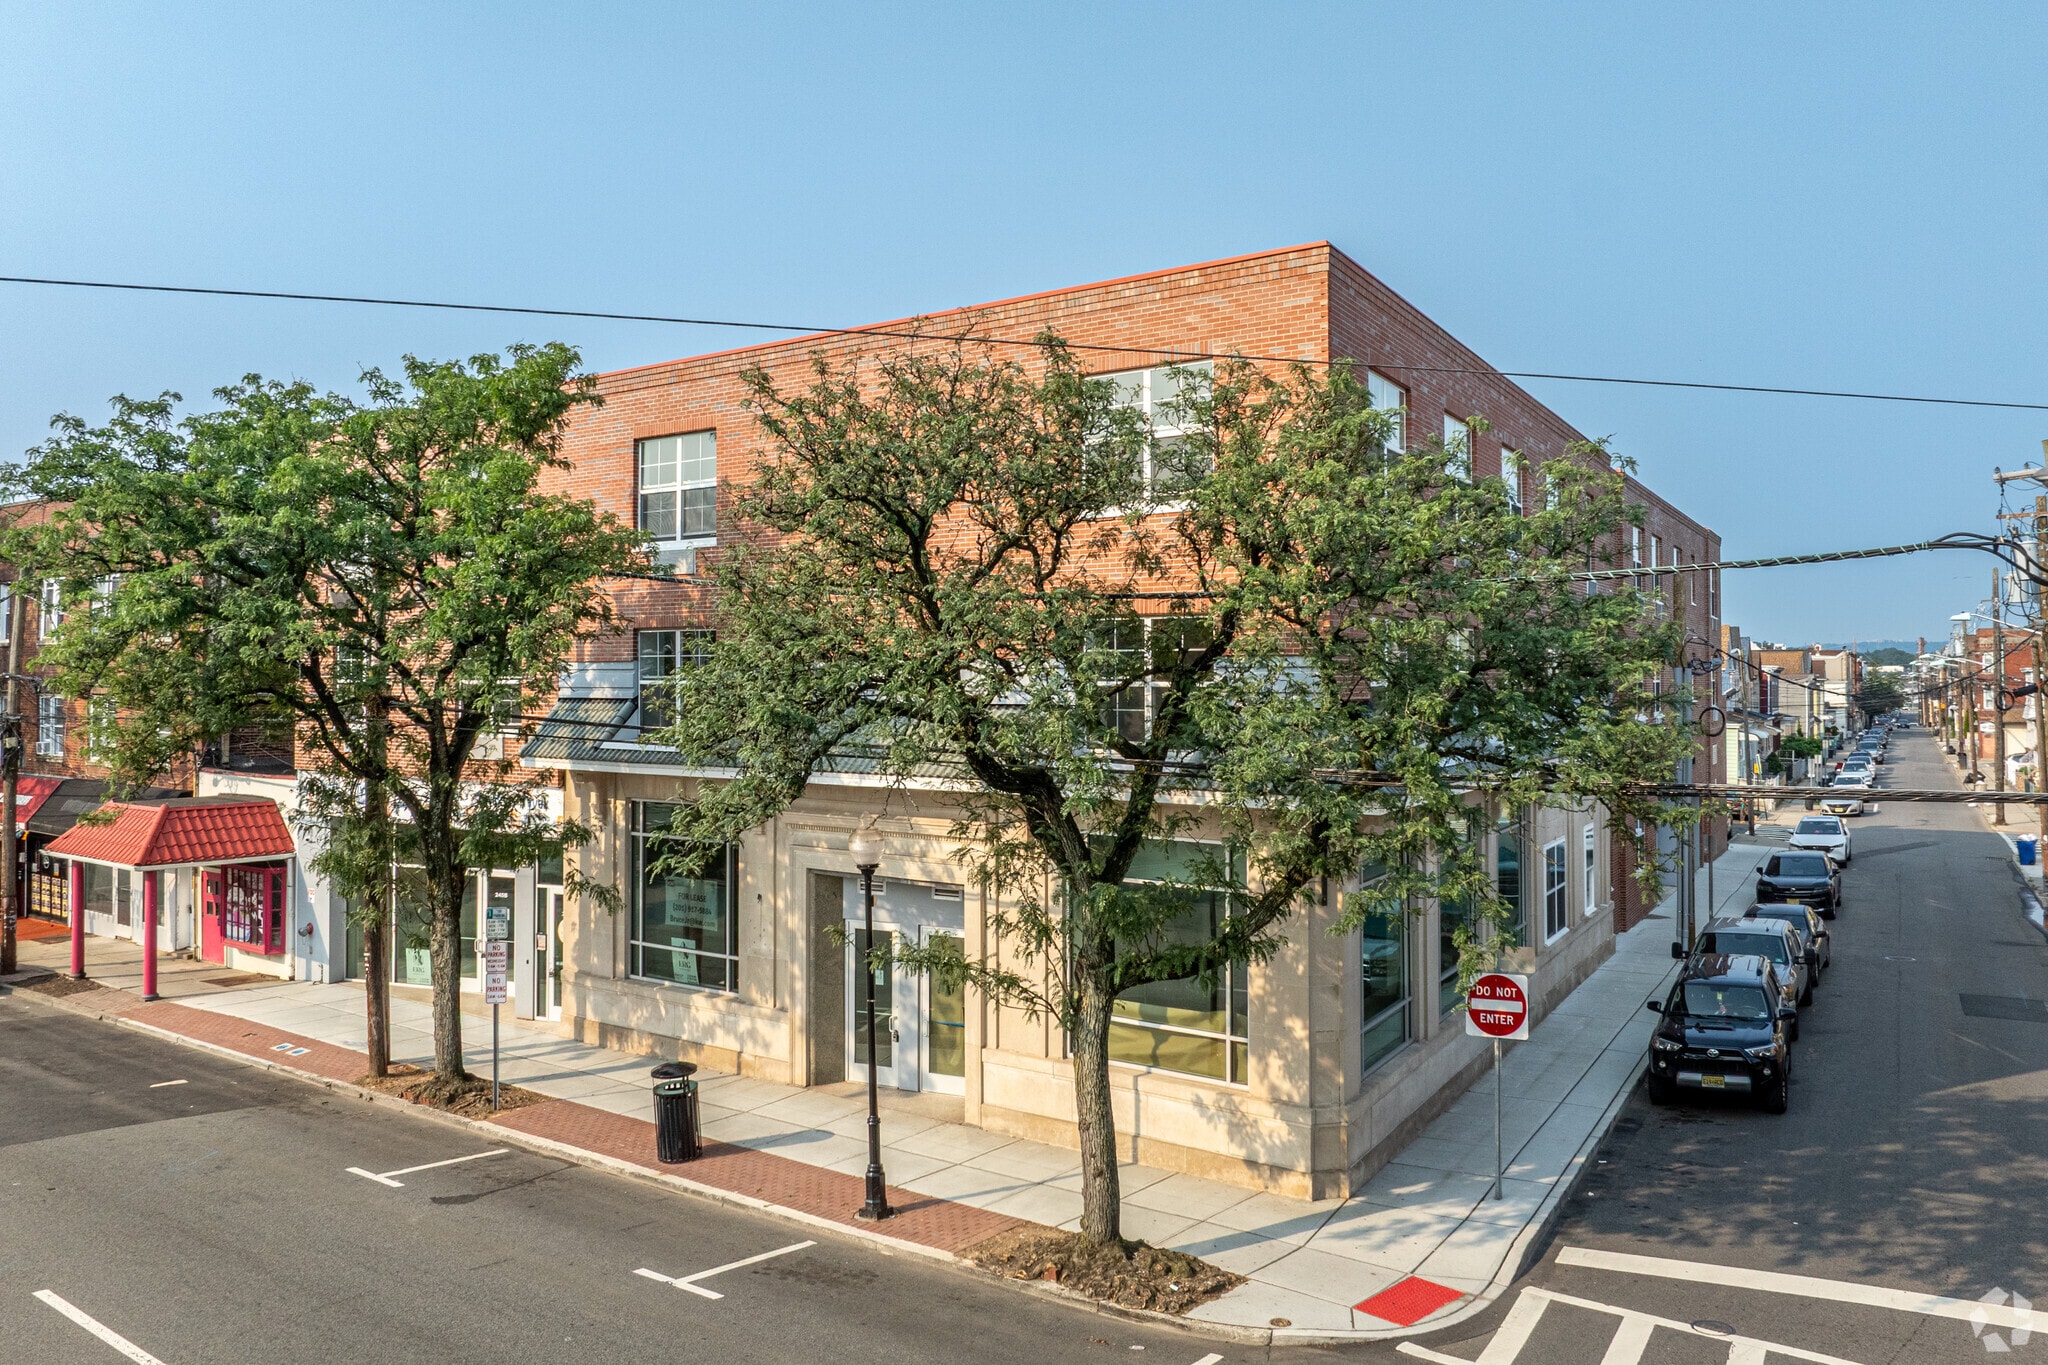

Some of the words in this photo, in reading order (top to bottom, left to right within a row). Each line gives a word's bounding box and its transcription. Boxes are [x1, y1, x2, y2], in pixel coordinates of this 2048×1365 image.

[678, 892, 689, 900] FOR
[690, 894, 706, 902] LEASE
[673, 902, 686, 913] (201)
[1476, 985, 1491, 996] DO
[1496, 986, 1518, 998] NOT
[1480, 1013, 1514, 1026] ENTER
